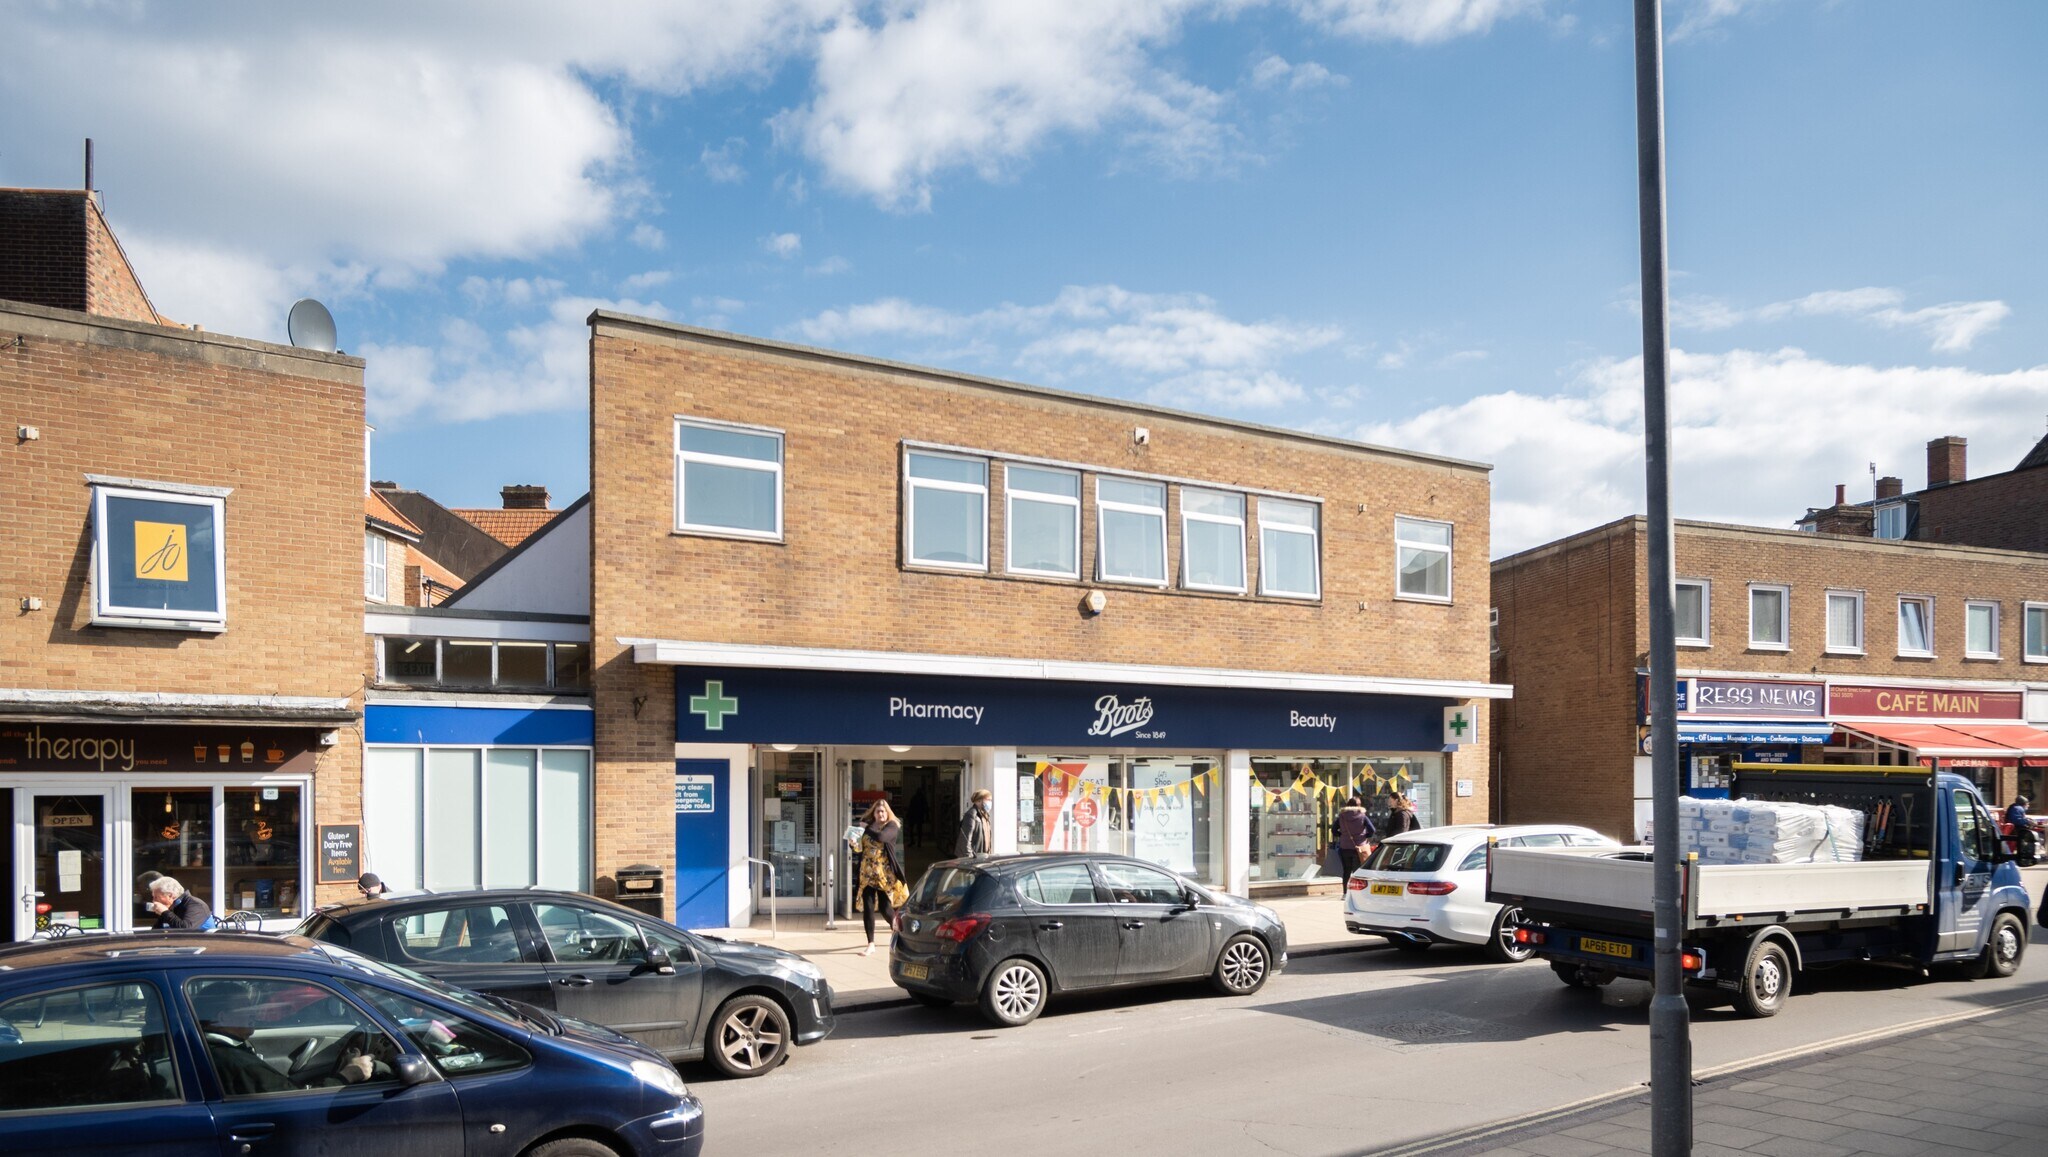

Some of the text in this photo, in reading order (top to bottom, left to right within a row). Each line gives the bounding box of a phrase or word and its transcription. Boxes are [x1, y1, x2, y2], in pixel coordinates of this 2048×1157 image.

[1759, 687, 1816, 706] NEWS
[1876, 691, 1928, 713] CAFÉ
[1932, 694, 1980, 713] MAIN
[889, 697, 984, 725] Pharmacy
[1087, 694, 1154, 738] Boots
[1290, 710, 1337, 733] Beauty
[1135, 730, 1167, 739] Since 1849
[25, 725, 135, 772] therapy
[1971, 759, 1989, 767] MAIN
[1154, 777, 1172, 786] Shop
[52, 816, 84, 825] OPEN
[328, 832, 346, 840] Gluten
[323, 840, 353, 850] Dairy Free
[331, 849, 348, 857] Items
[328, 857, 353, 866] Available
[333, 866, 346, 874] Here
[1584, 939, 1628, 955] AP66 ETO
